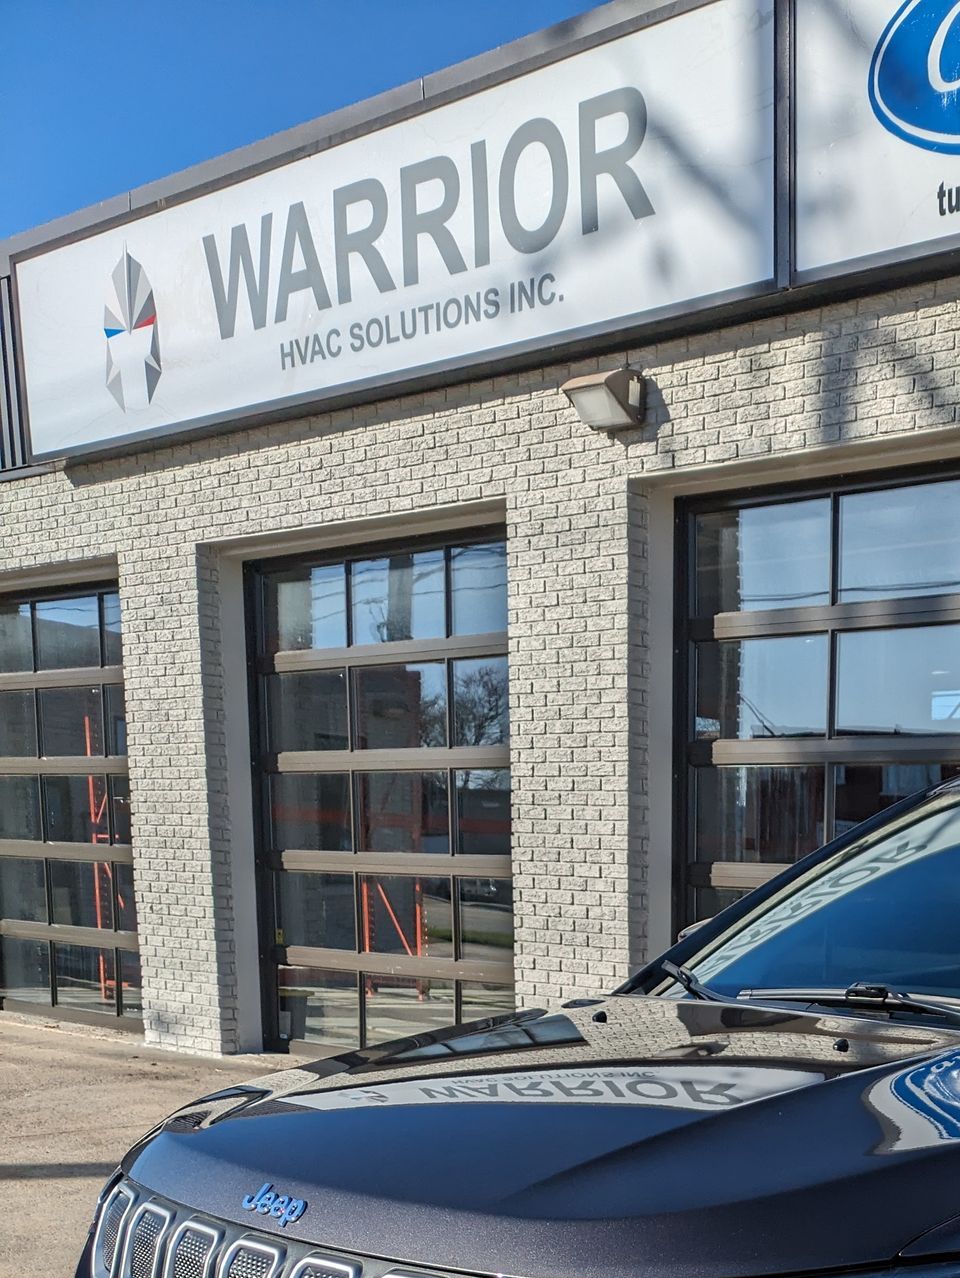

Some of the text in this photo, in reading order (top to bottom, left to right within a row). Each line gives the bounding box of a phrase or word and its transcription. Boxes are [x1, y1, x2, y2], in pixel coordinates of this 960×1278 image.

[203, 86, 655, 340] WARRIOR
[279, 272, 565, 371] HVAC SOLUTIONS INC.
[242, 1183, 308, 1228] Jeep
